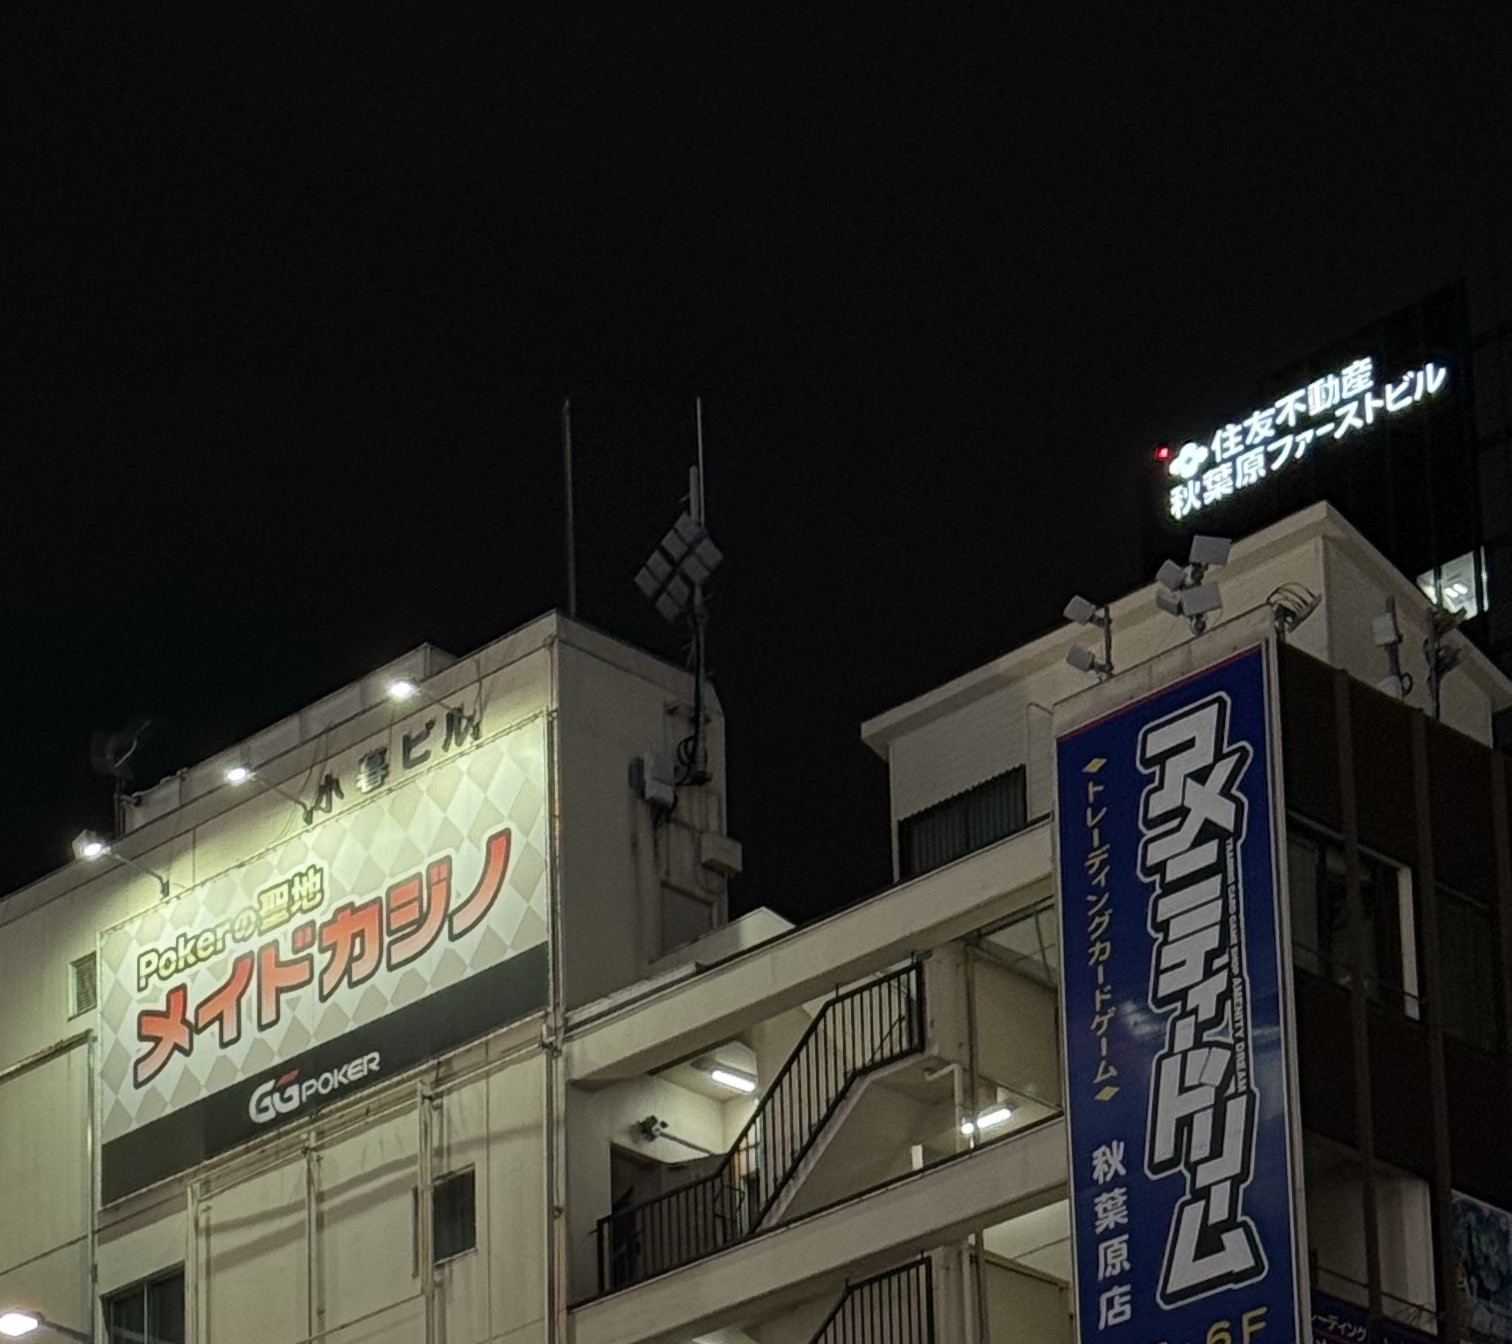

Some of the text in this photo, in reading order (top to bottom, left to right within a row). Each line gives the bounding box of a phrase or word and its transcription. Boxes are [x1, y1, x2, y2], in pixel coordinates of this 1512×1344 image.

[1168, 362, 1446, 521] 秋葉原ファーストビル
[1210, 356, 1374, 464] 住友不動産
[133, 827, 512, 1090] メイドカジノ
[138, 865, 326, 992] Pokerの聖地
[1085, 782, 1118, 1084] トレーディングカードゲーム
[1092, 1140, 1132, 1330] 秋葉原店
